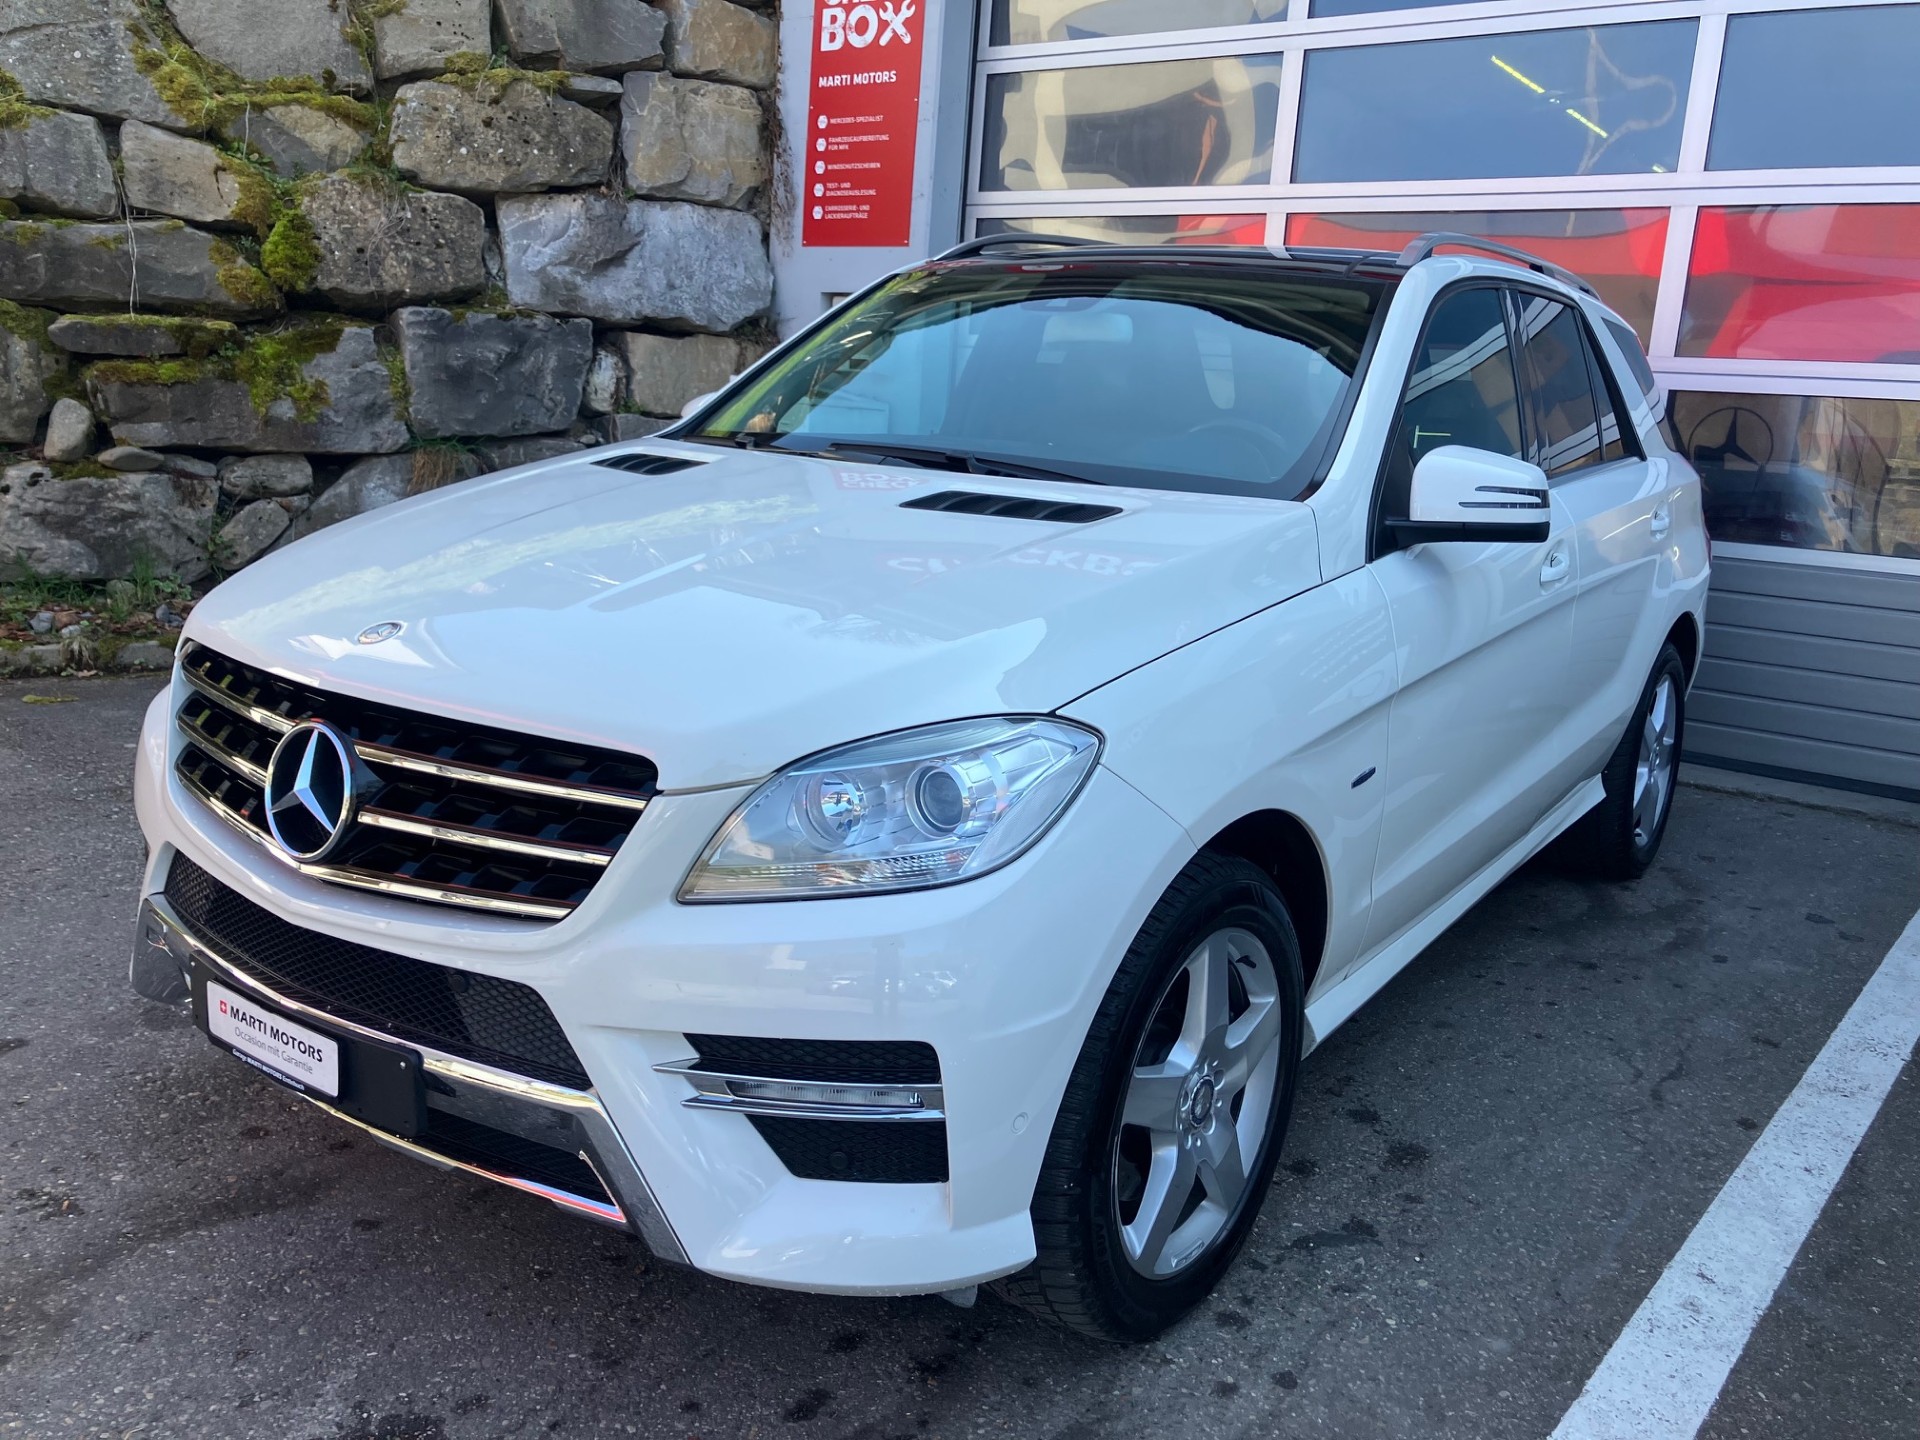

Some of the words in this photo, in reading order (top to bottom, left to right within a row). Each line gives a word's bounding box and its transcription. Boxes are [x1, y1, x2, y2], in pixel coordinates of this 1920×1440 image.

[820, 2, 916, 52] BOX
[818, 75, 851, 88] MARTI
[853, 70, 897, 86] MOTORS
[830, 115, 883, 124] MERCEDES-SPEZIALIST
[230, 1005, 267, 1036] MARTI
[269, 1027, 323, 1063] MOTORS
[234, 1027, 267, 1050] Occasion
[267, 1043, 281, 1059] mit
[281, 1049, 313, 1075] Garantie
